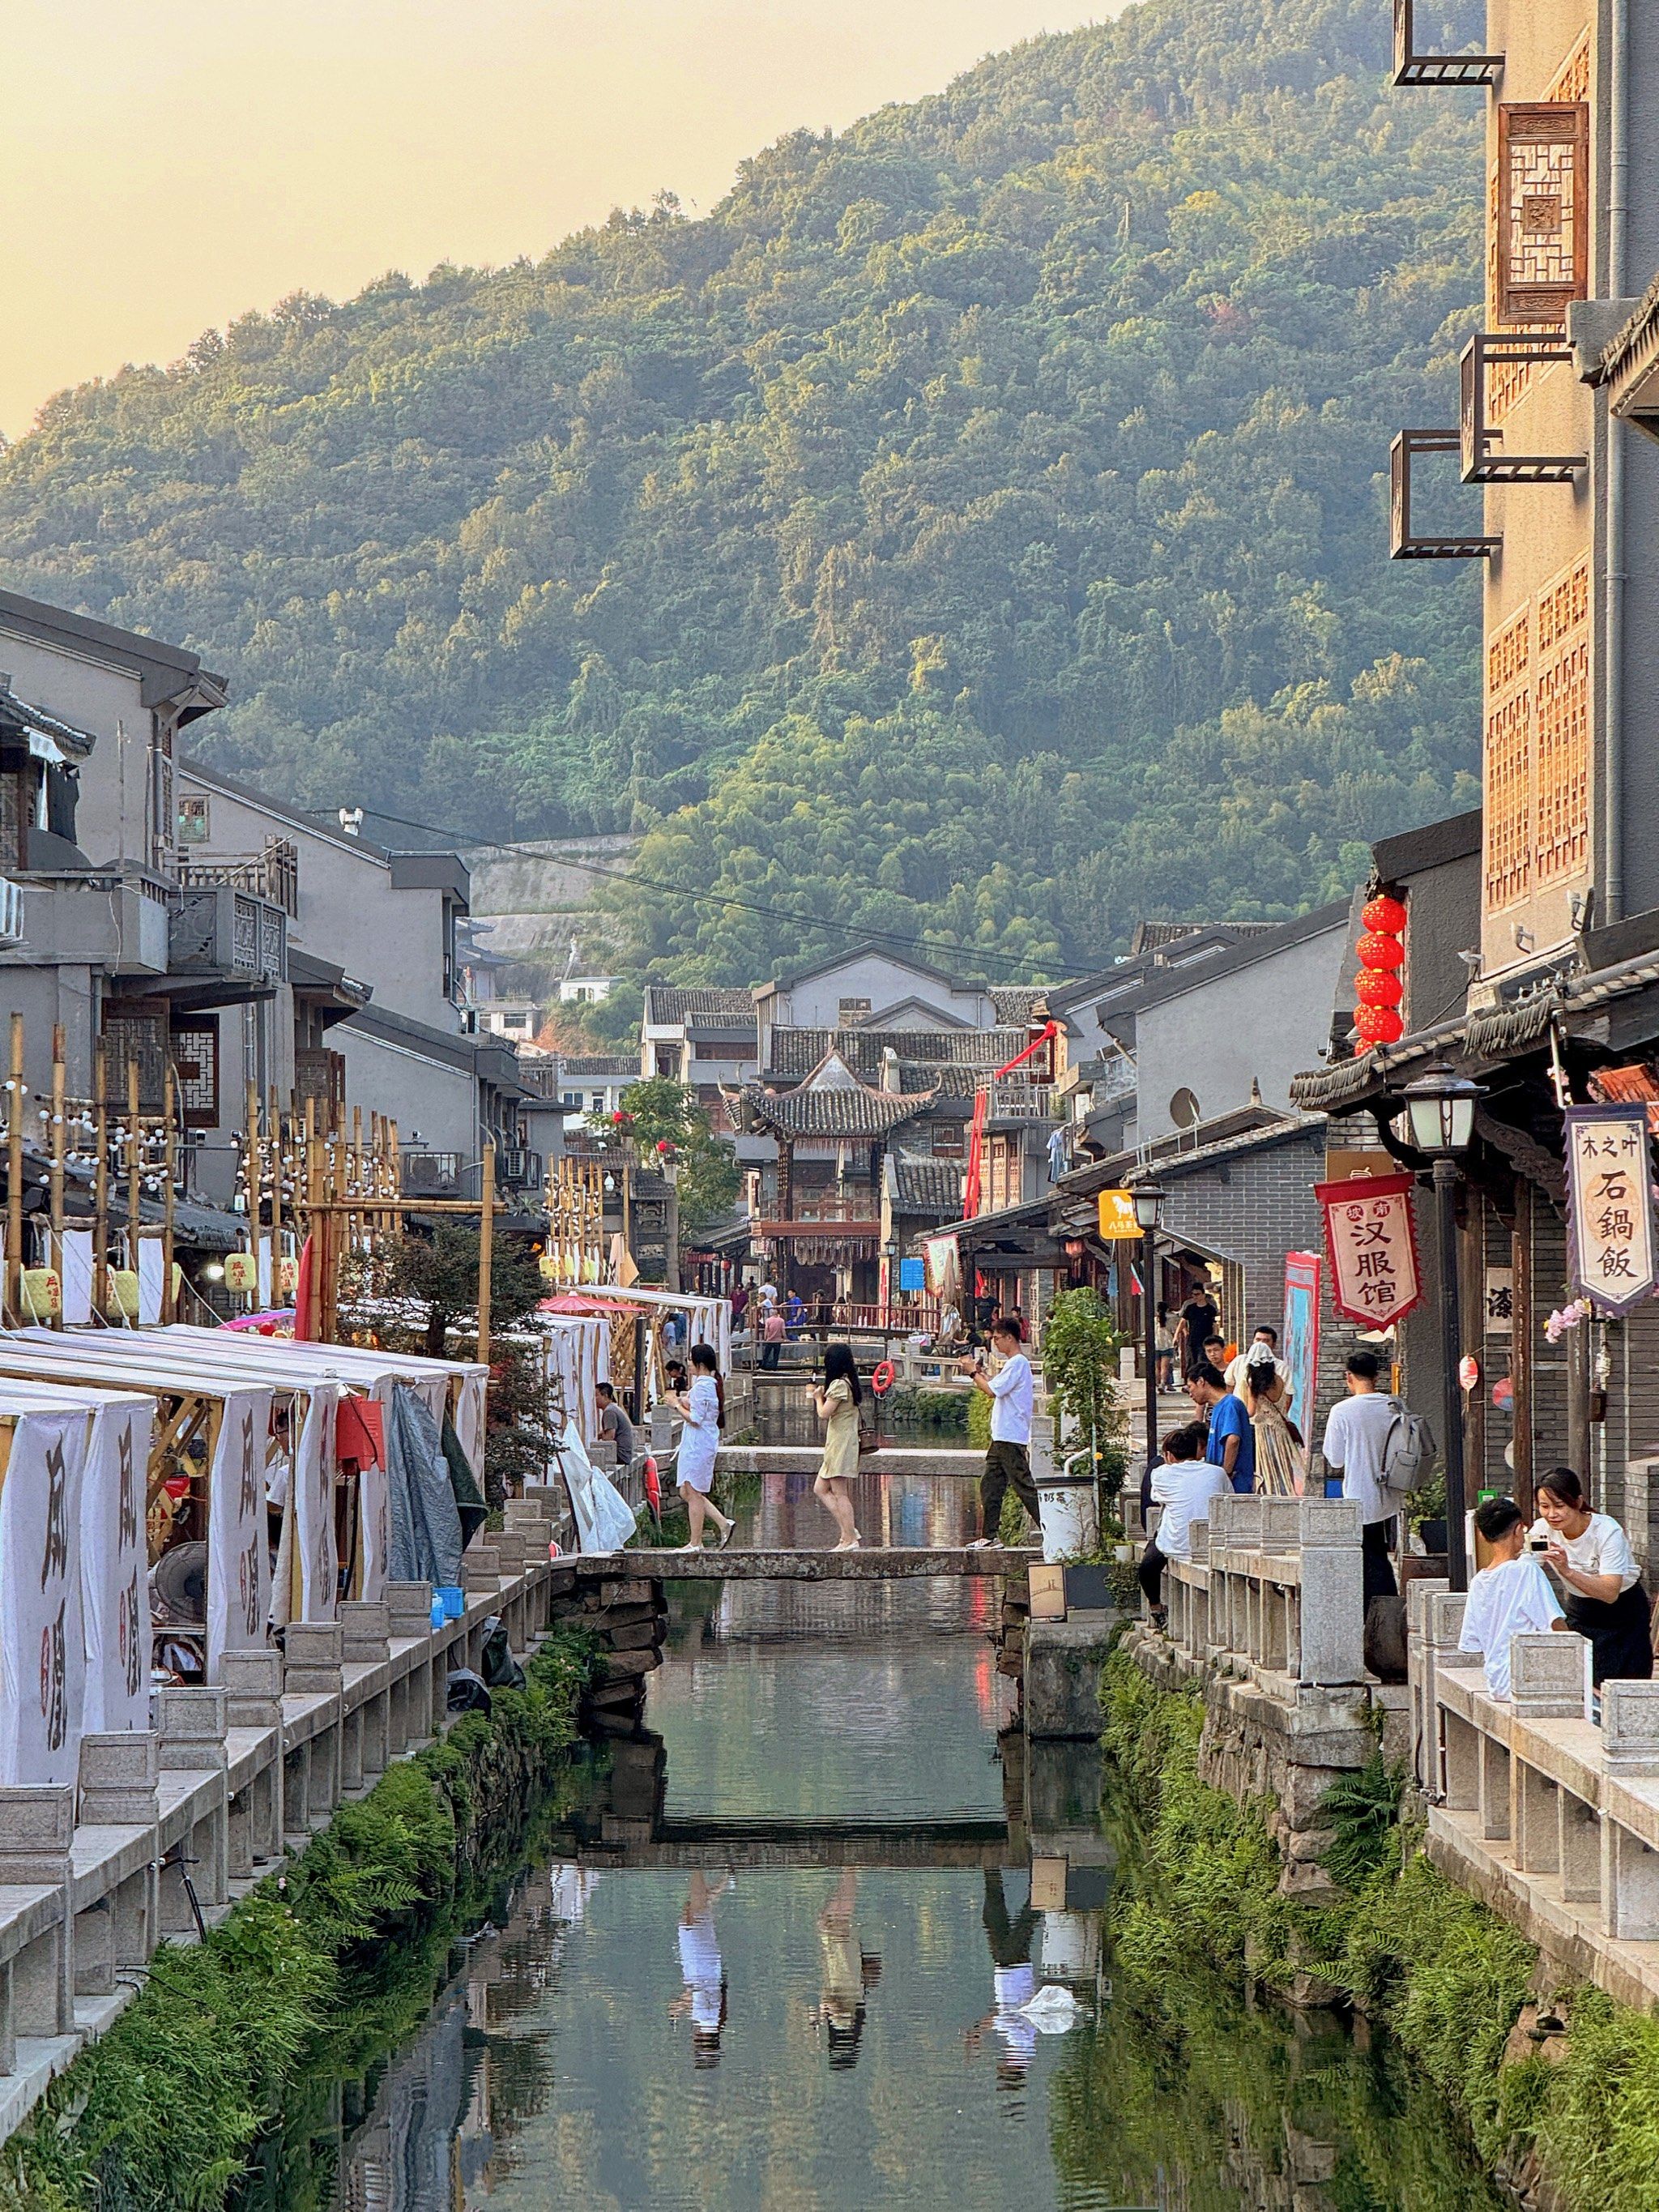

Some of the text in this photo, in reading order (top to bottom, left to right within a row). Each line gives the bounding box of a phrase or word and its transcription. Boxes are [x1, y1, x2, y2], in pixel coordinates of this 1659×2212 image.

[1582, 1136, 1637, 1159] 木之叶
[1350, 1221, 1396, 1306] 汉服馆
[1594, 1170, 1638, 1278] 石鍋飯
